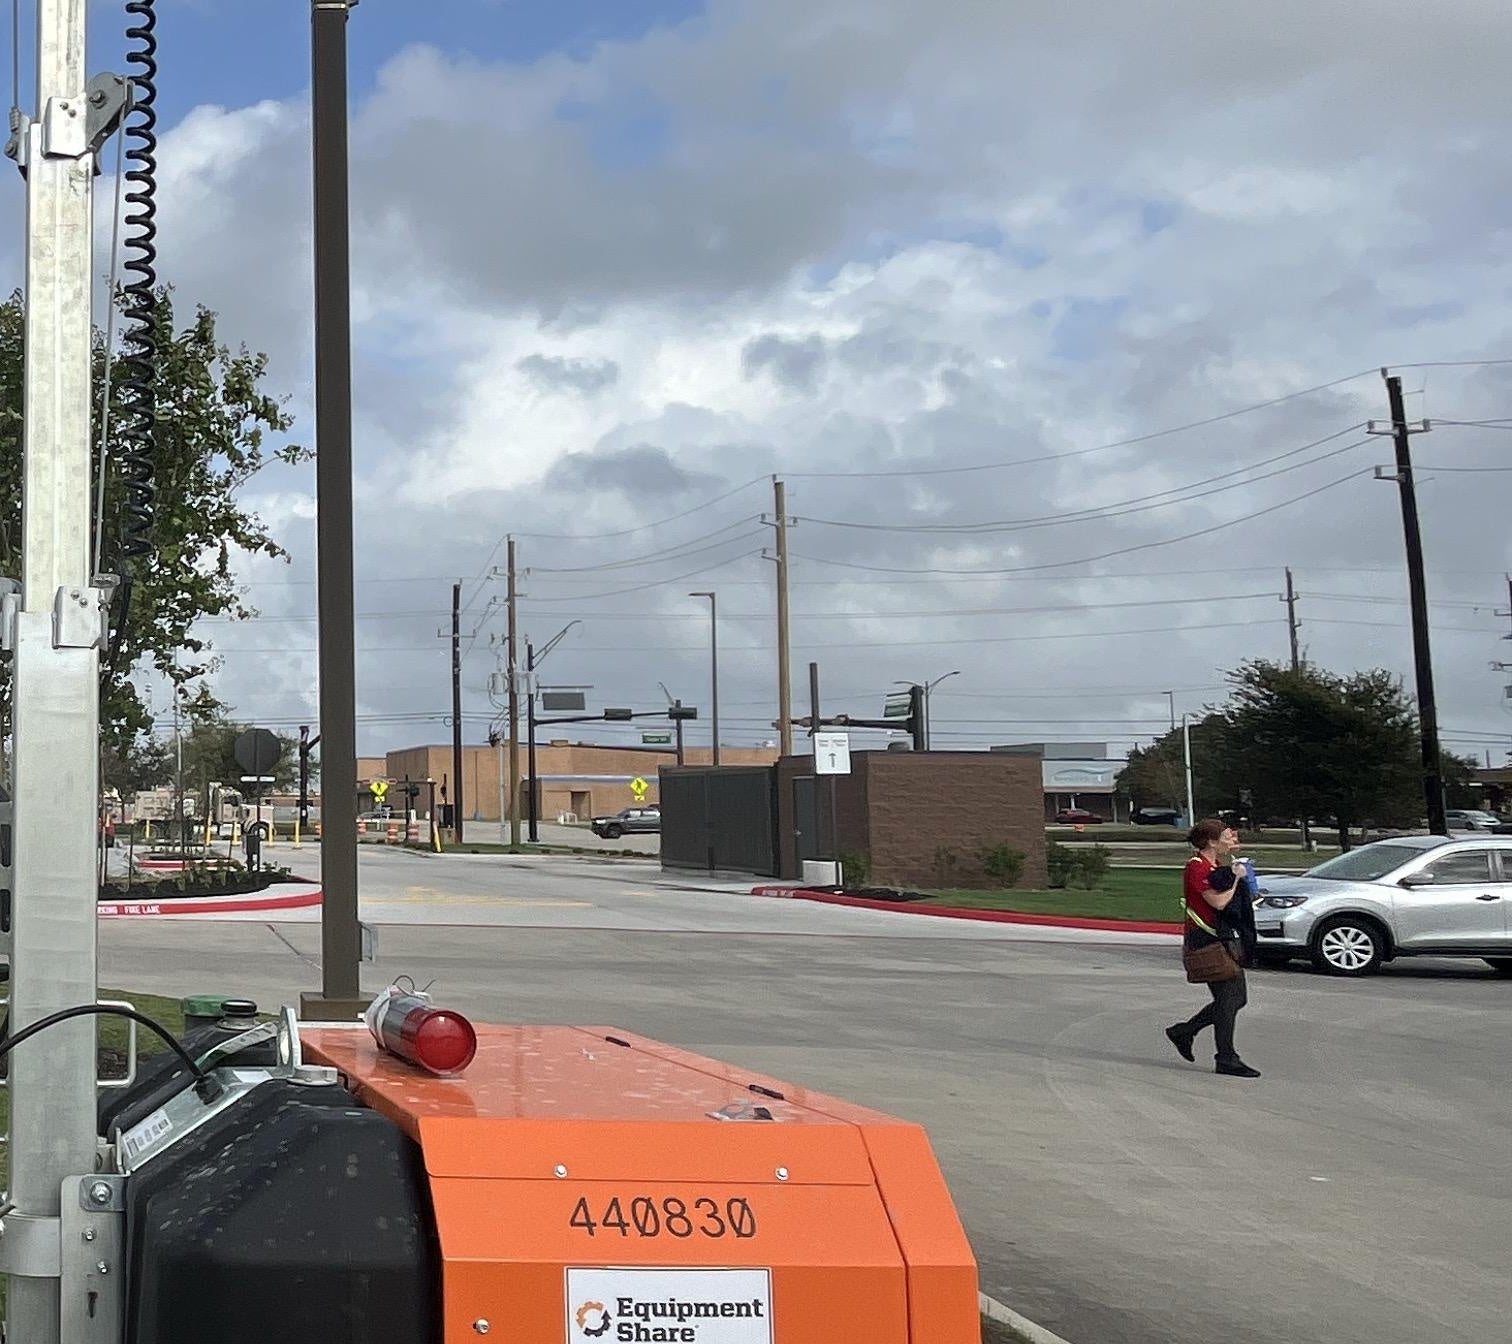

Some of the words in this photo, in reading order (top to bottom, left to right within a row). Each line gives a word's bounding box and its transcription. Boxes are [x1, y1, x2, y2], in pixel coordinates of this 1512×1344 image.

[569, 1196, 757, 1238] 440830
[616, 1297, 764, 1322] Equipment
[616, 1322, 697, 1343] Share
